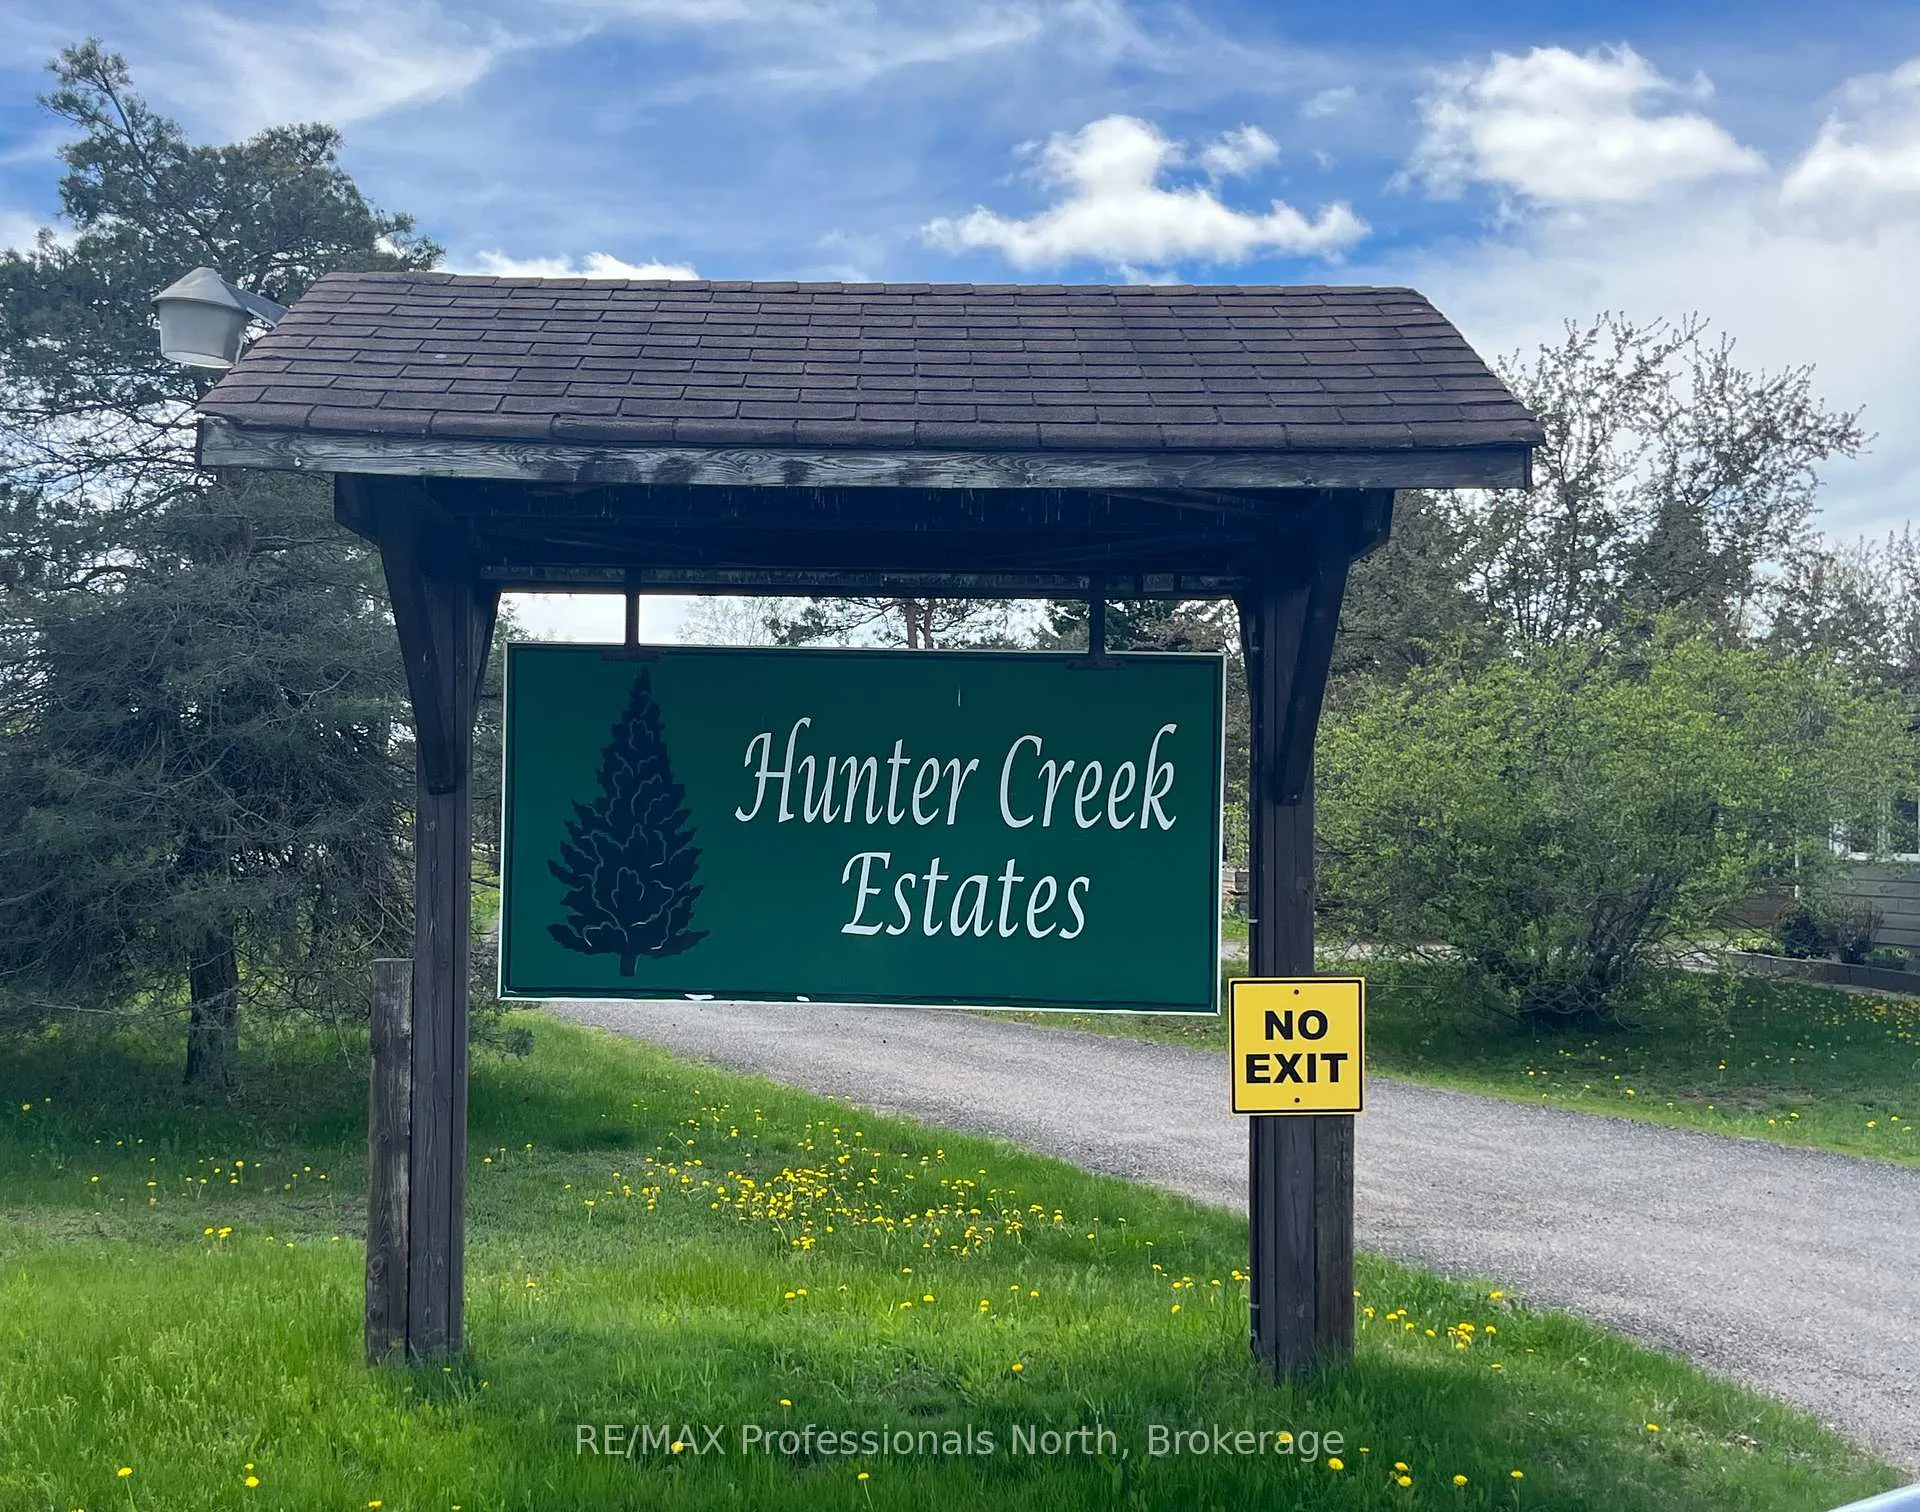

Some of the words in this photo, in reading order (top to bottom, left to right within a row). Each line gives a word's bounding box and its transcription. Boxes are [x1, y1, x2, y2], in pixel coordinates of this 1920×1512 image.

[734, 717, 980, 826] Hunter
[999, 723, 1177, 831] Creek
[841, 851, 1091, 940] Estates
[1264, 1009, 1329, 1041] NO
[1245, 1052, 1349, 1084] EXIT
